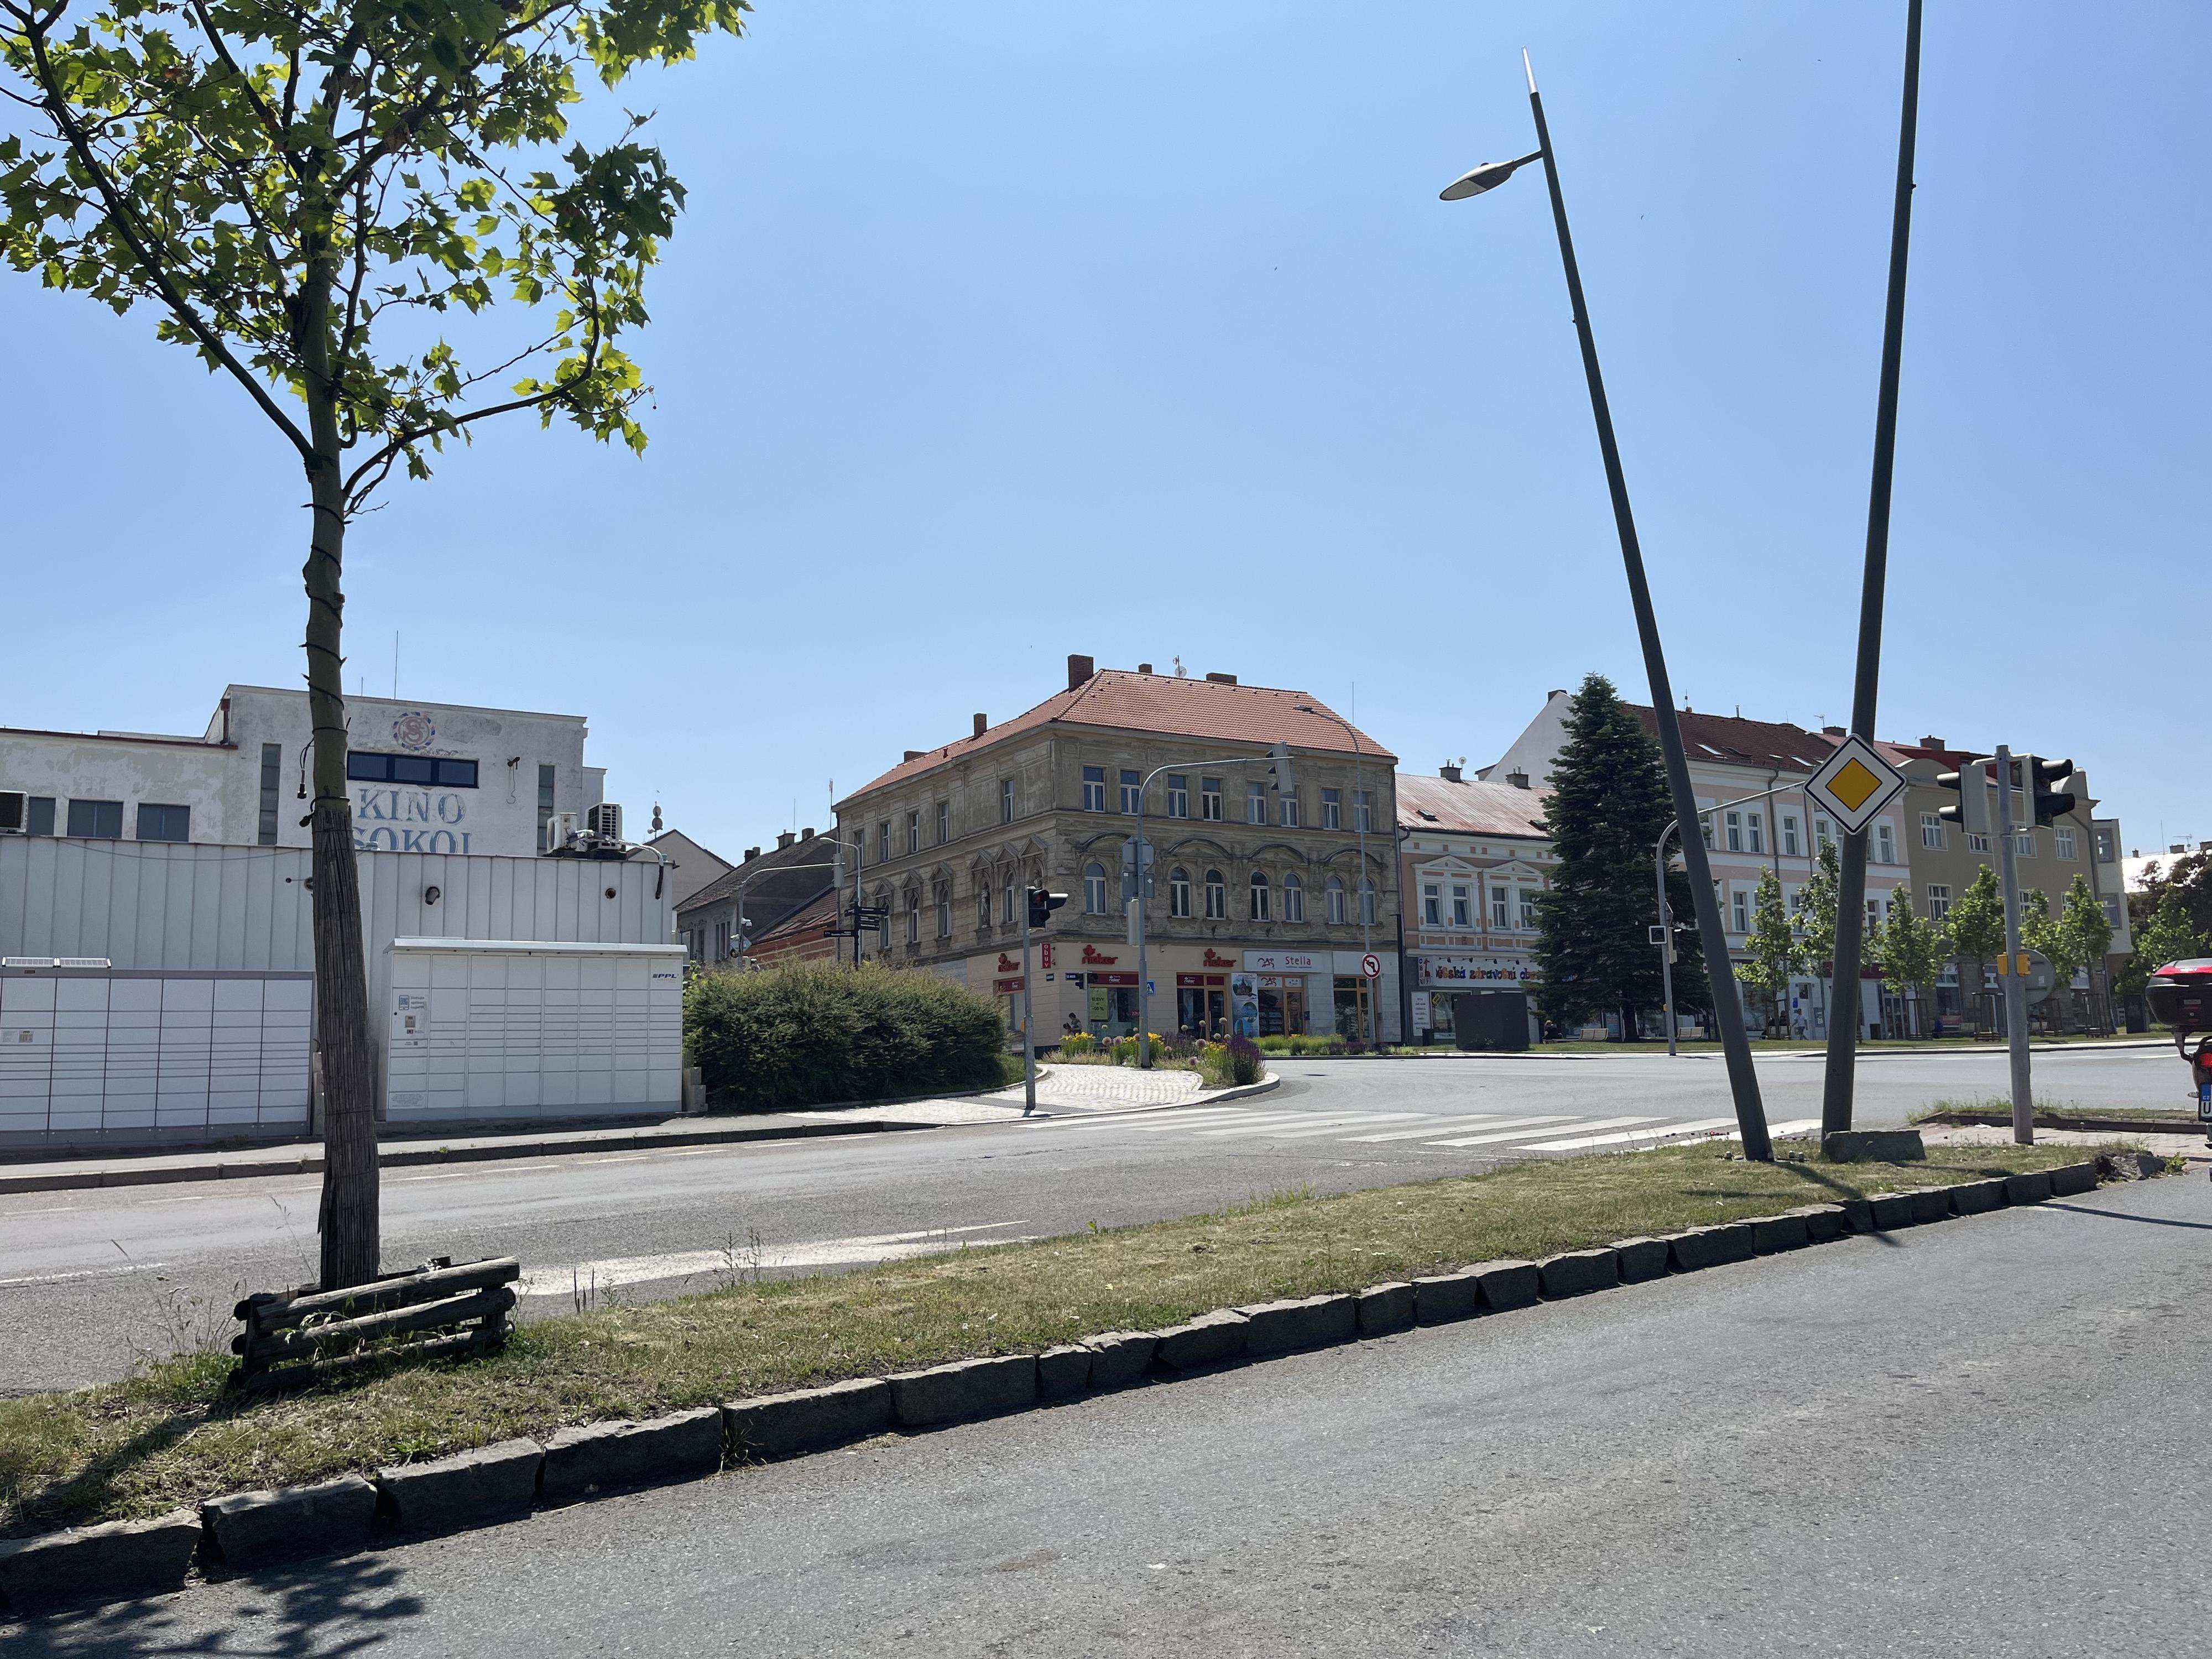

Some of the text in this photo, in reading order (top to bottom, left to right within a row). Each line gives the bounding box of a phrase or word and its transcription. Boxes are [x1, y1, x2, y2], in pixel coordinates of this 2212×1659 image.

[358, 788, 467, 825] KINO
[1082, 953, 1118, 964] rieker
[1203, 956, 1237, 967] rieker
[1285, 956, 1311, 965] Stella
[1469, 967, 1517, 980] zdravotní
